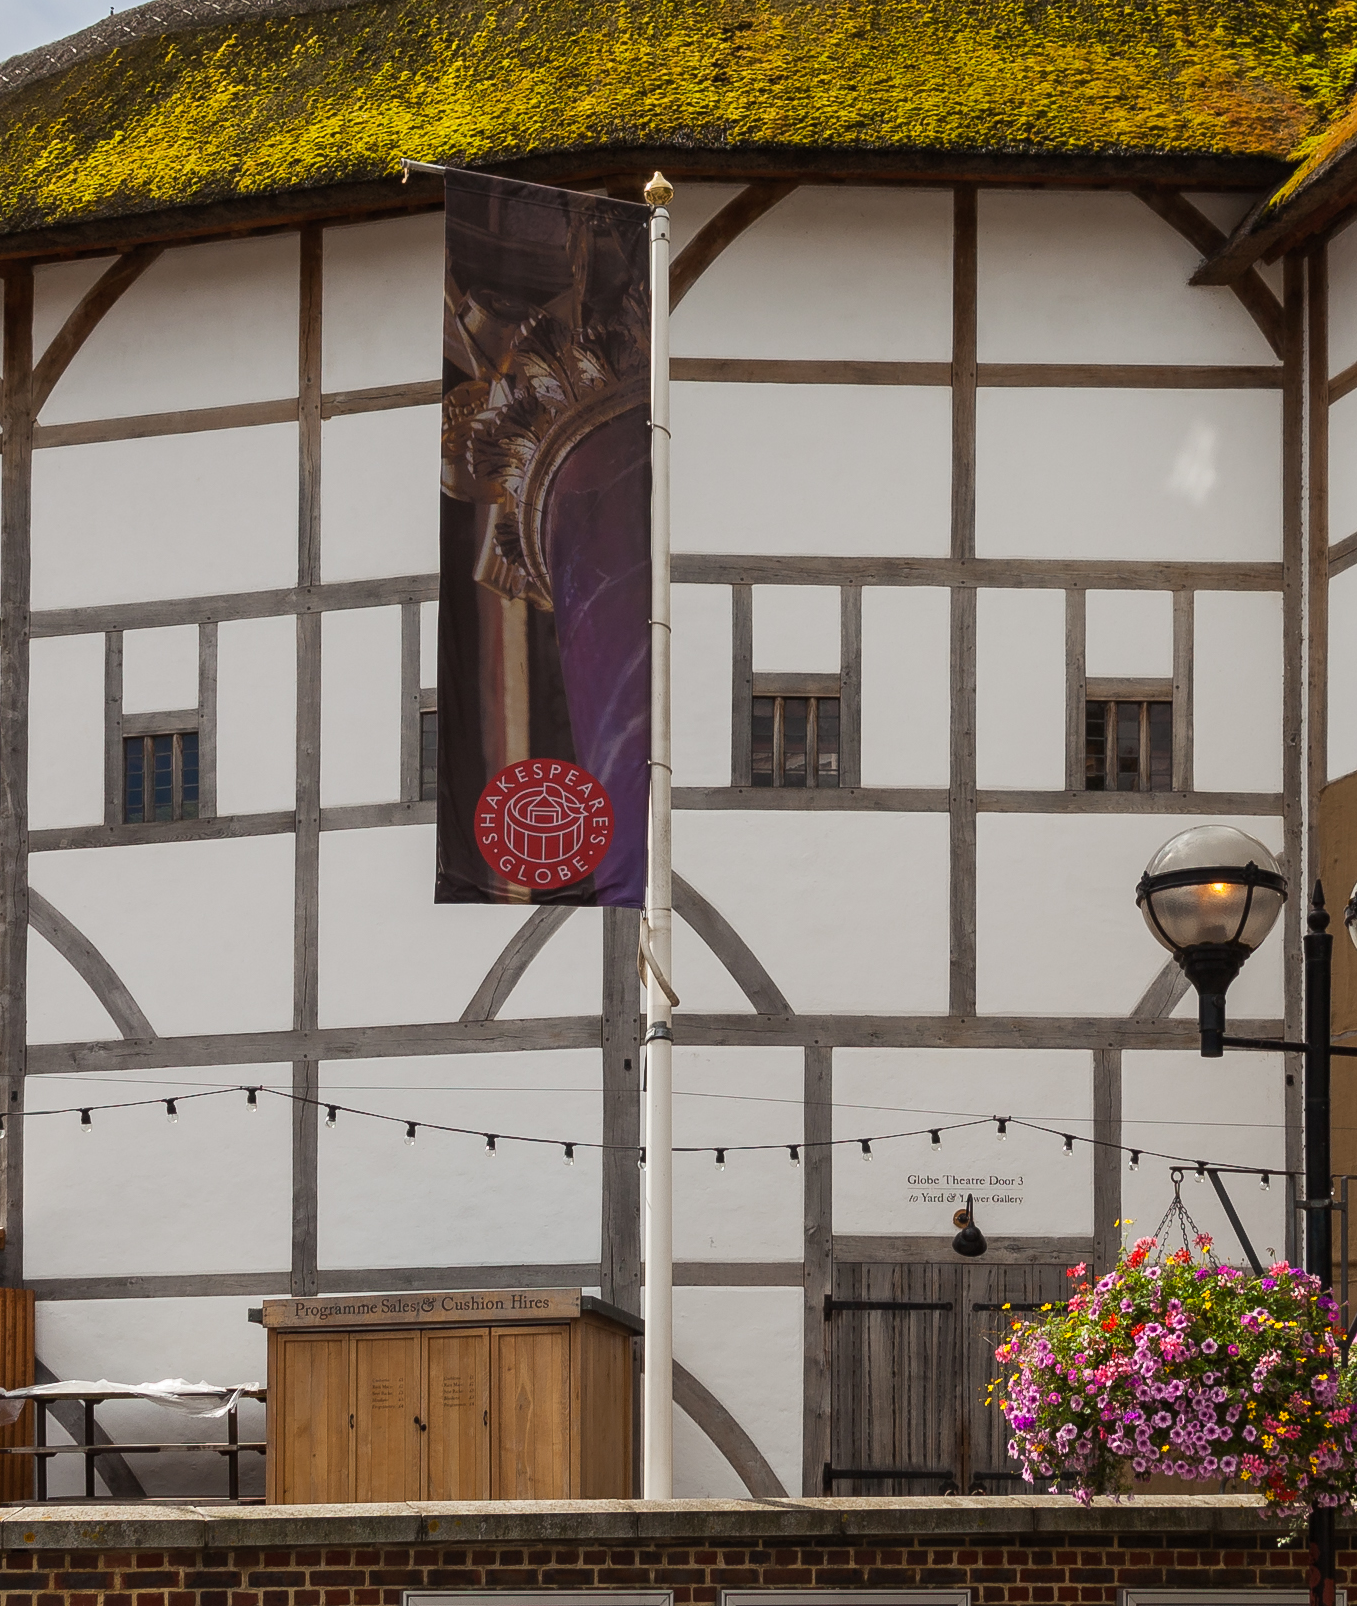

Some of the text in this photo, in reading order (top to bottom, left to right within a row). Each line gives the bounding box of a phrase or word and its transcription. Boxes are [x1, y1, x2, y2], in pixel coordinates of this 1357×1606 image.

[481, 764, 608, 846] SHAKESPEARE'S
[500, 855, 588, 883] GLOBE
[907, 1174, 1024, 1185] Globe Theatre Door 3
[908, 1193, 1024, 1204] to Yard & Lwer Gallery
[295, 1294, 550, 1320] Programme Sales & Cushion Hires
